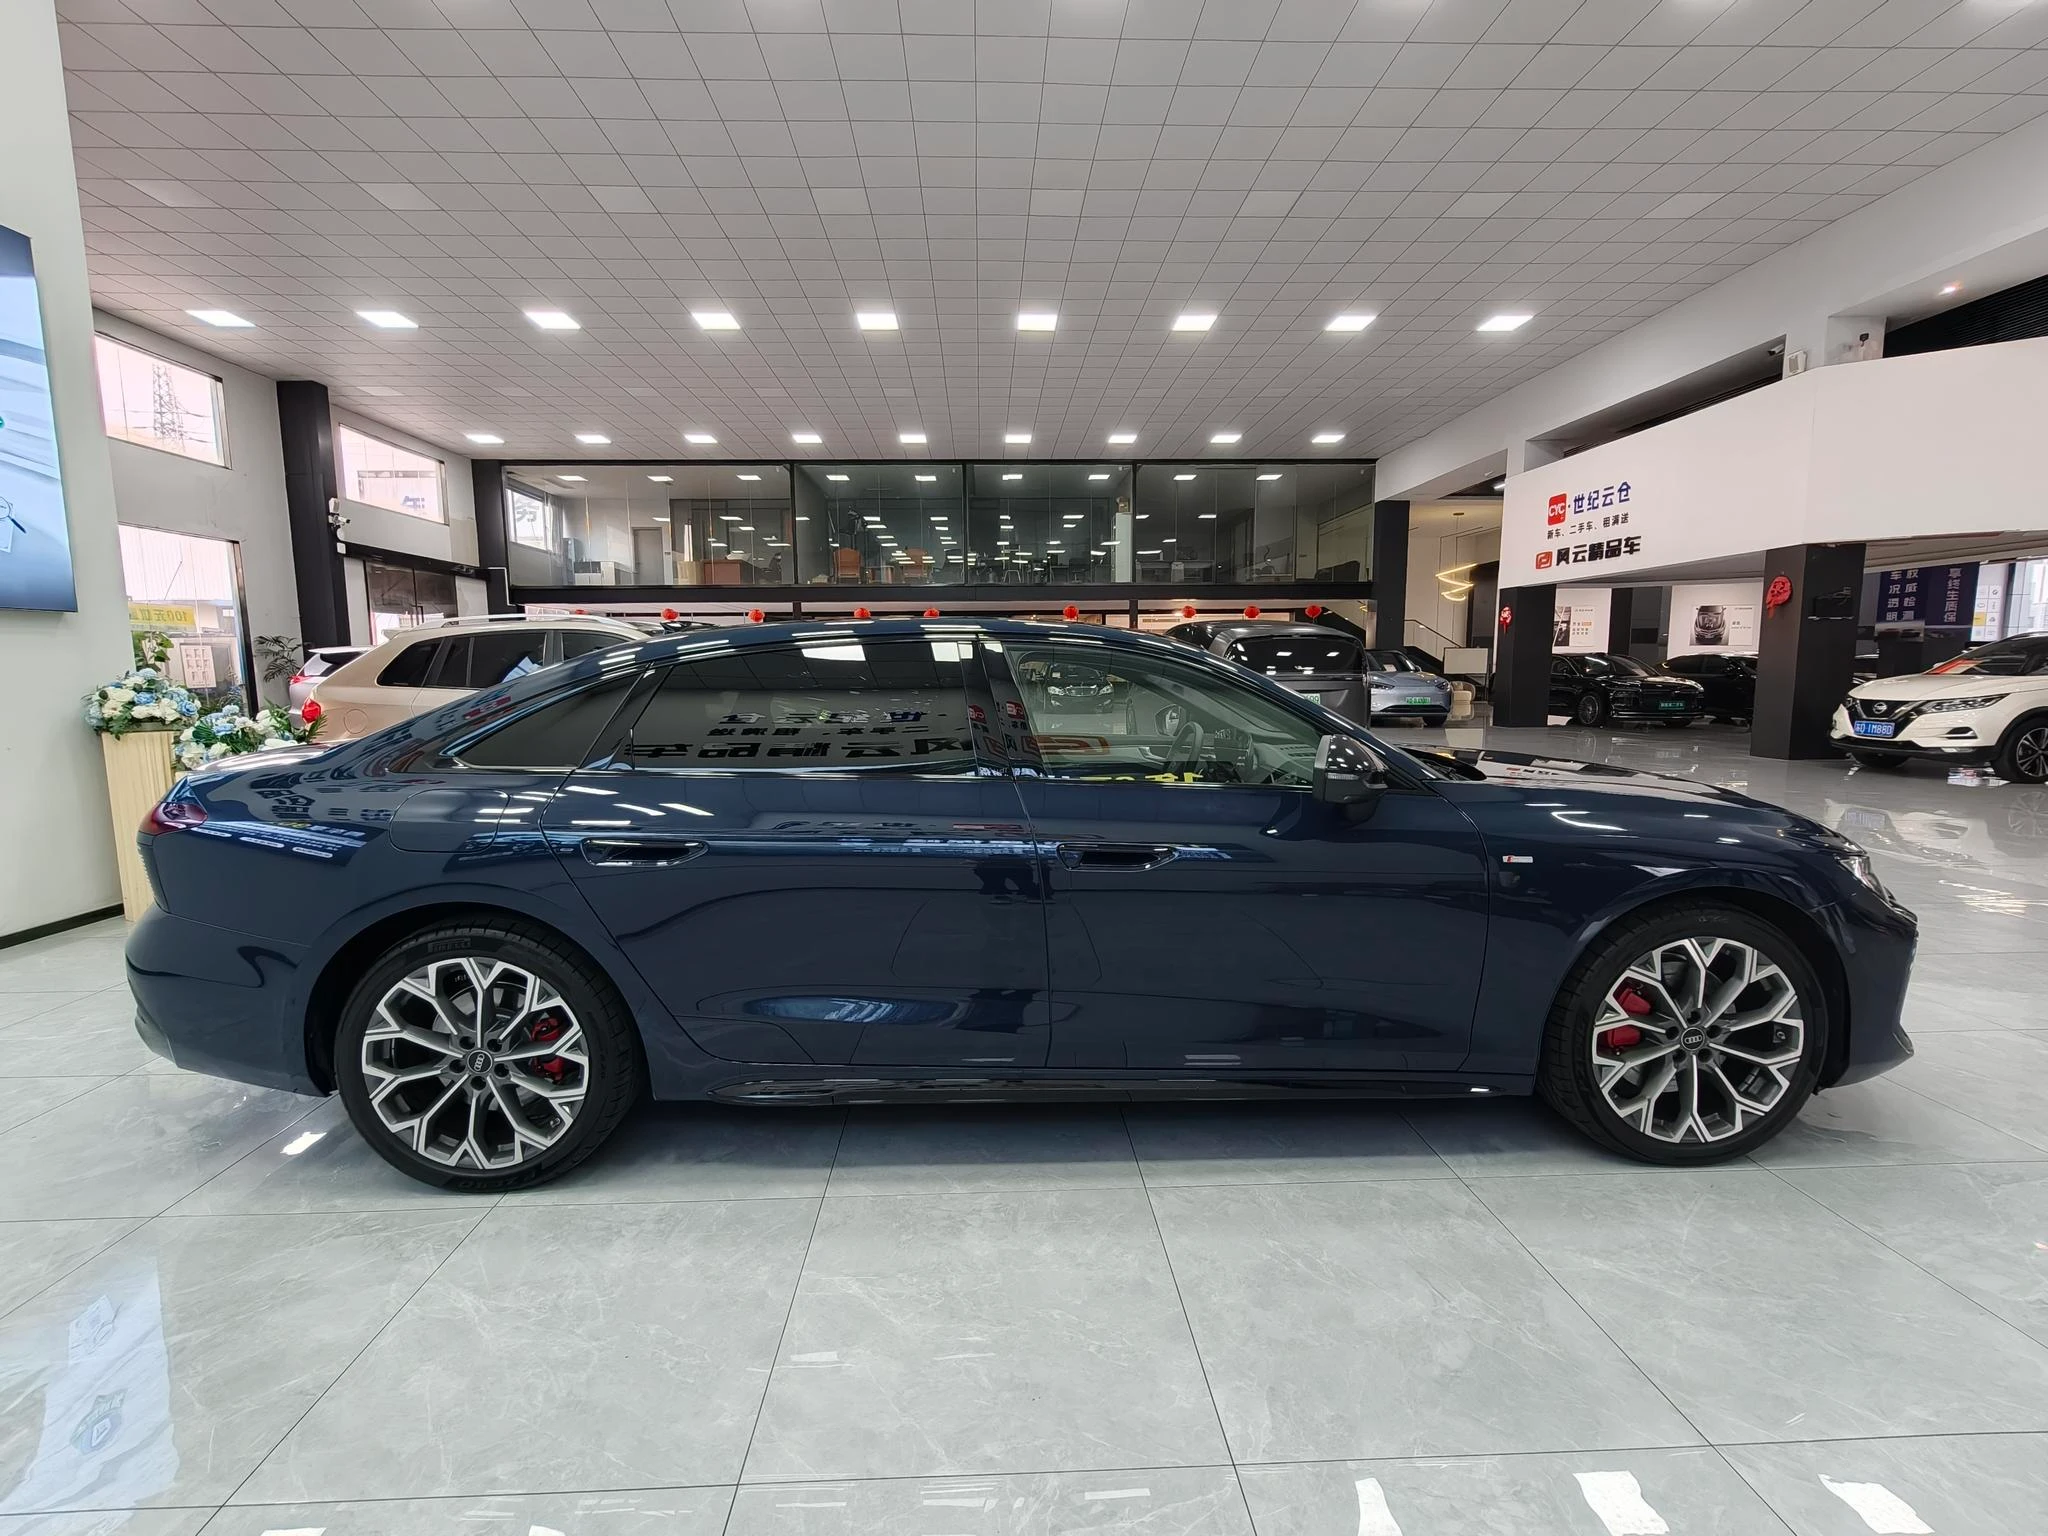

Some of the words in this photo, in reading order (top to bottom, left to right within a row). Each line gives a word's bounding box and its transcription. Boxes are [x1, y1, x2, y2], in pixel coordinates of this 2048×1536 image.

[1548, 502, 1566, 517] CYC
[1556, 535, 1642, 567] 风云精品车
